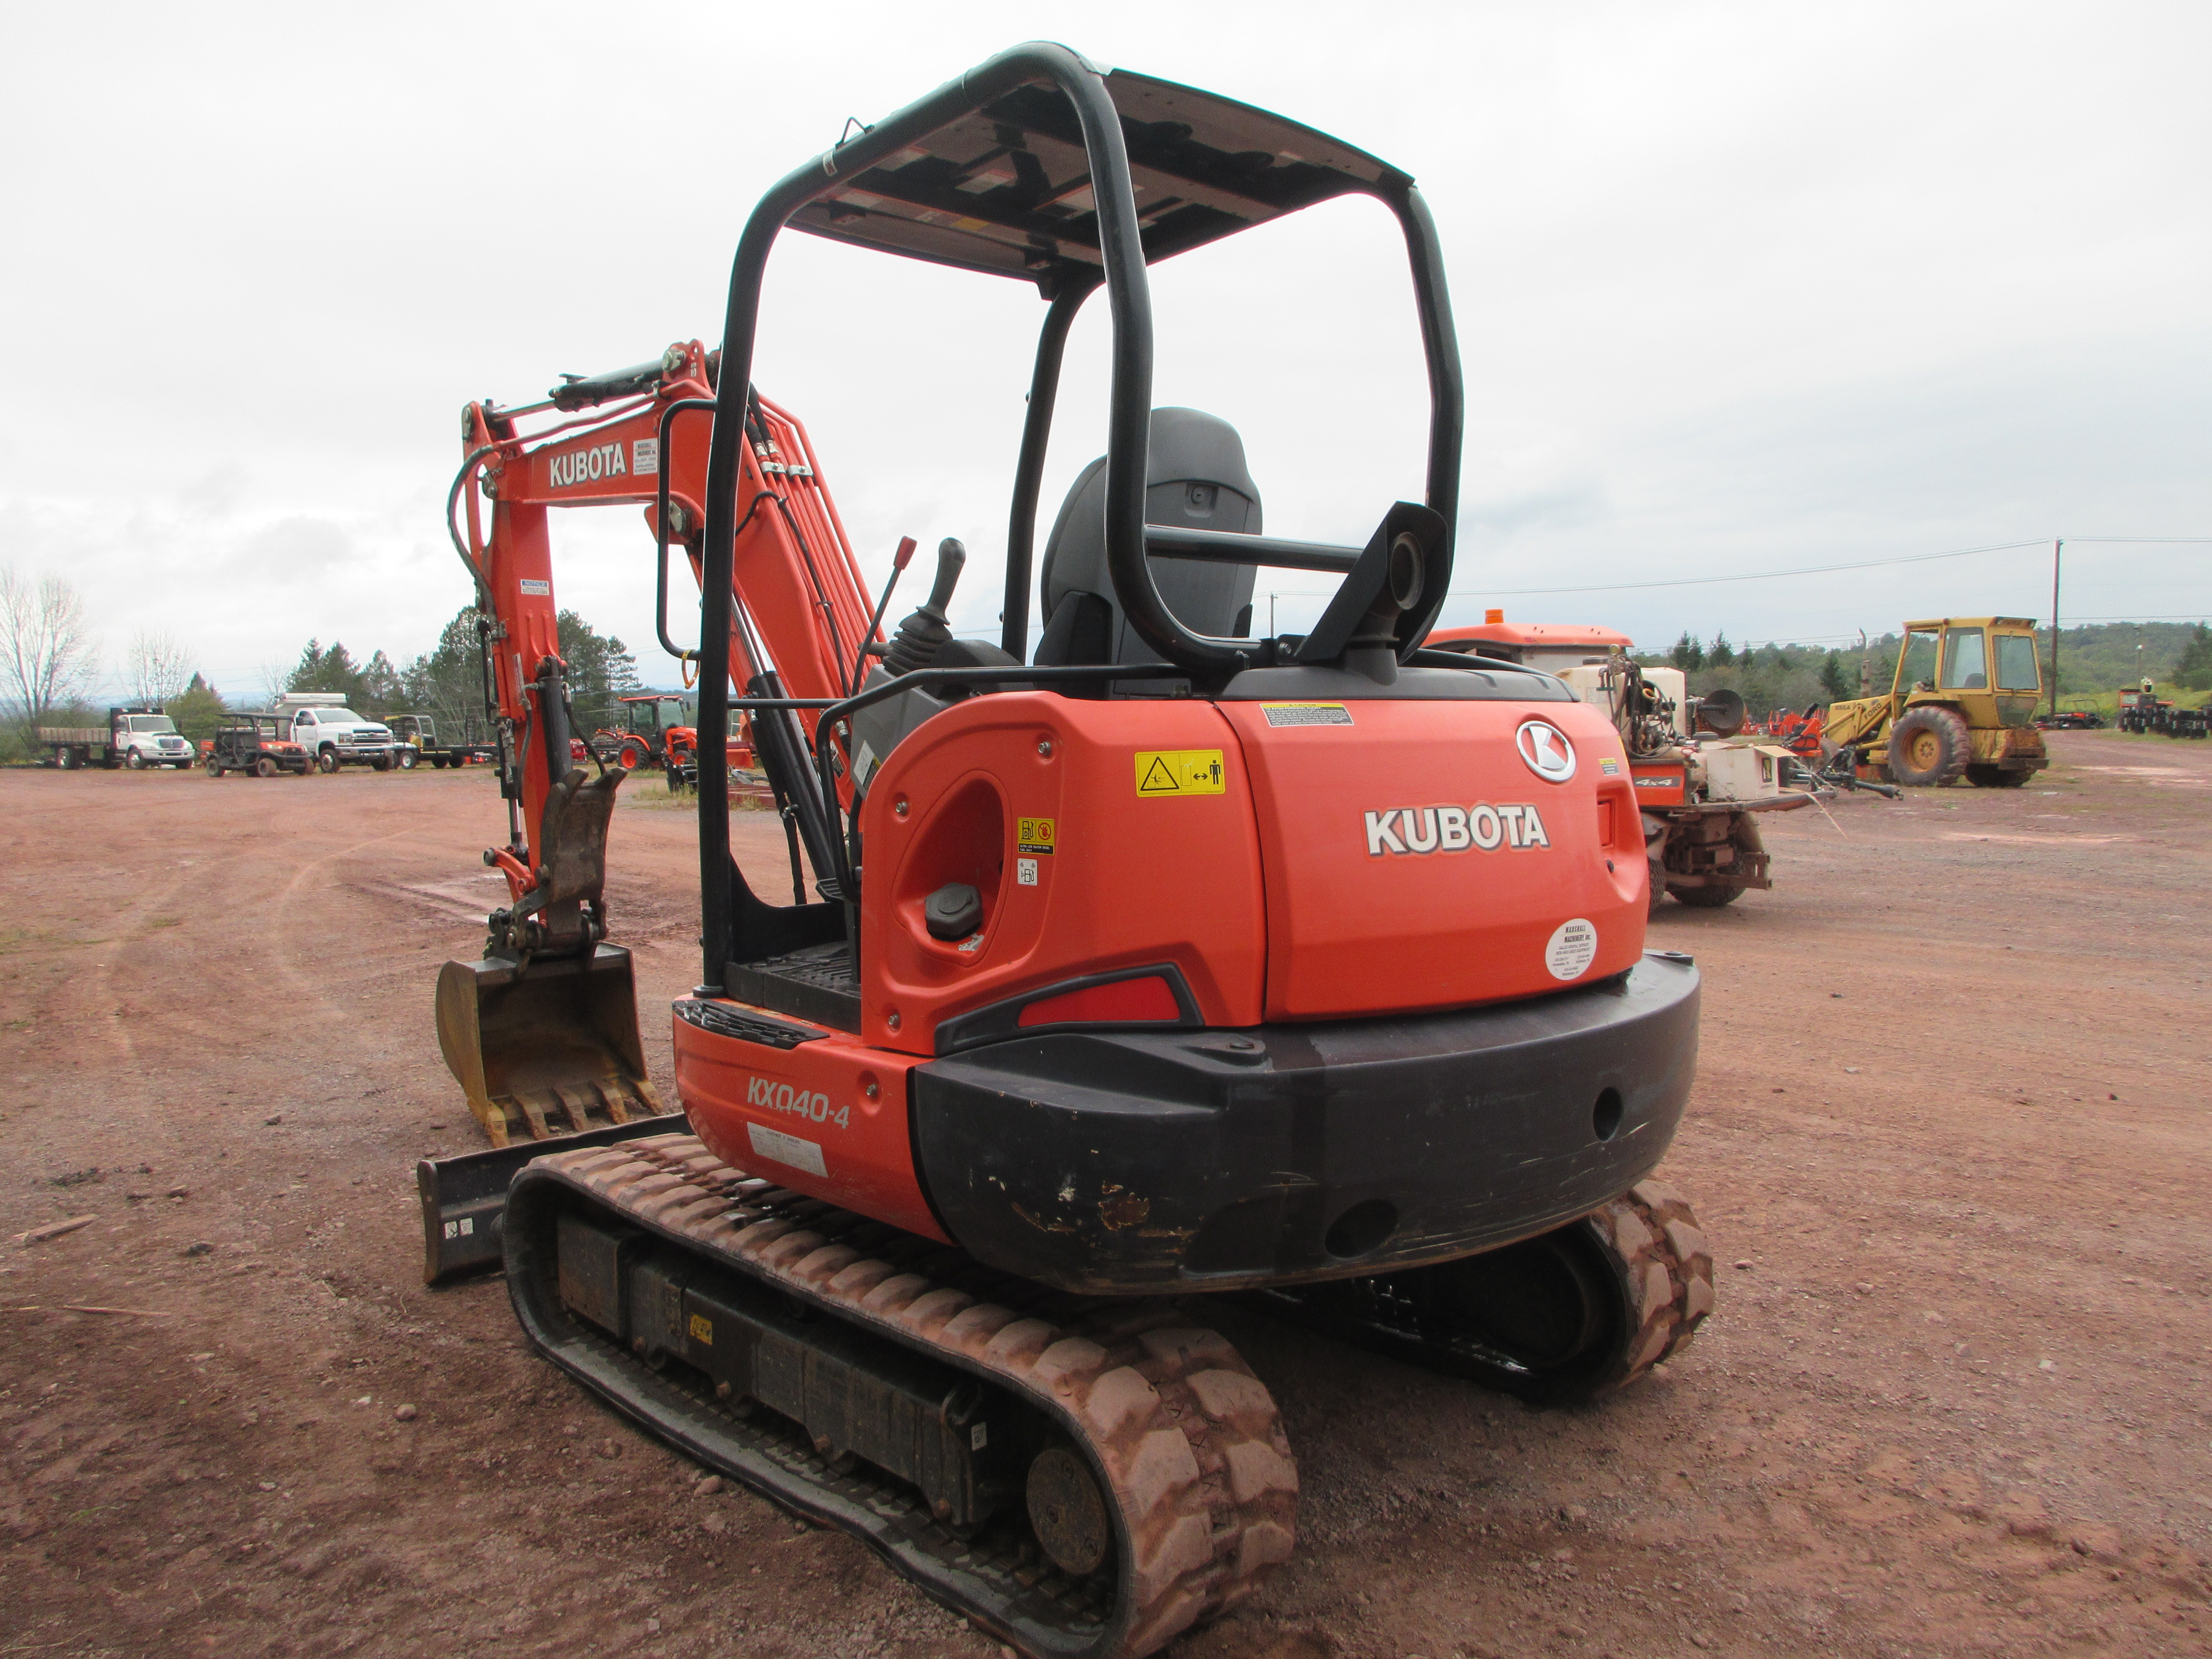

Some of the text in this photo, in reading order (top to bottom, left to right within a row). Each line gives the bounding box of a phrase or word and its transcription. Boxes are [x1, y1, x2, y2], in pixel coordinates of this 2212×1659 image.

[550, 441, 627, 488] KUBOTA
[1864, 703, 1882, 719] FORD
[1364, 805, 1550, 854] KUBOTA
[747, 1076, 850, 1129] KX040-4
